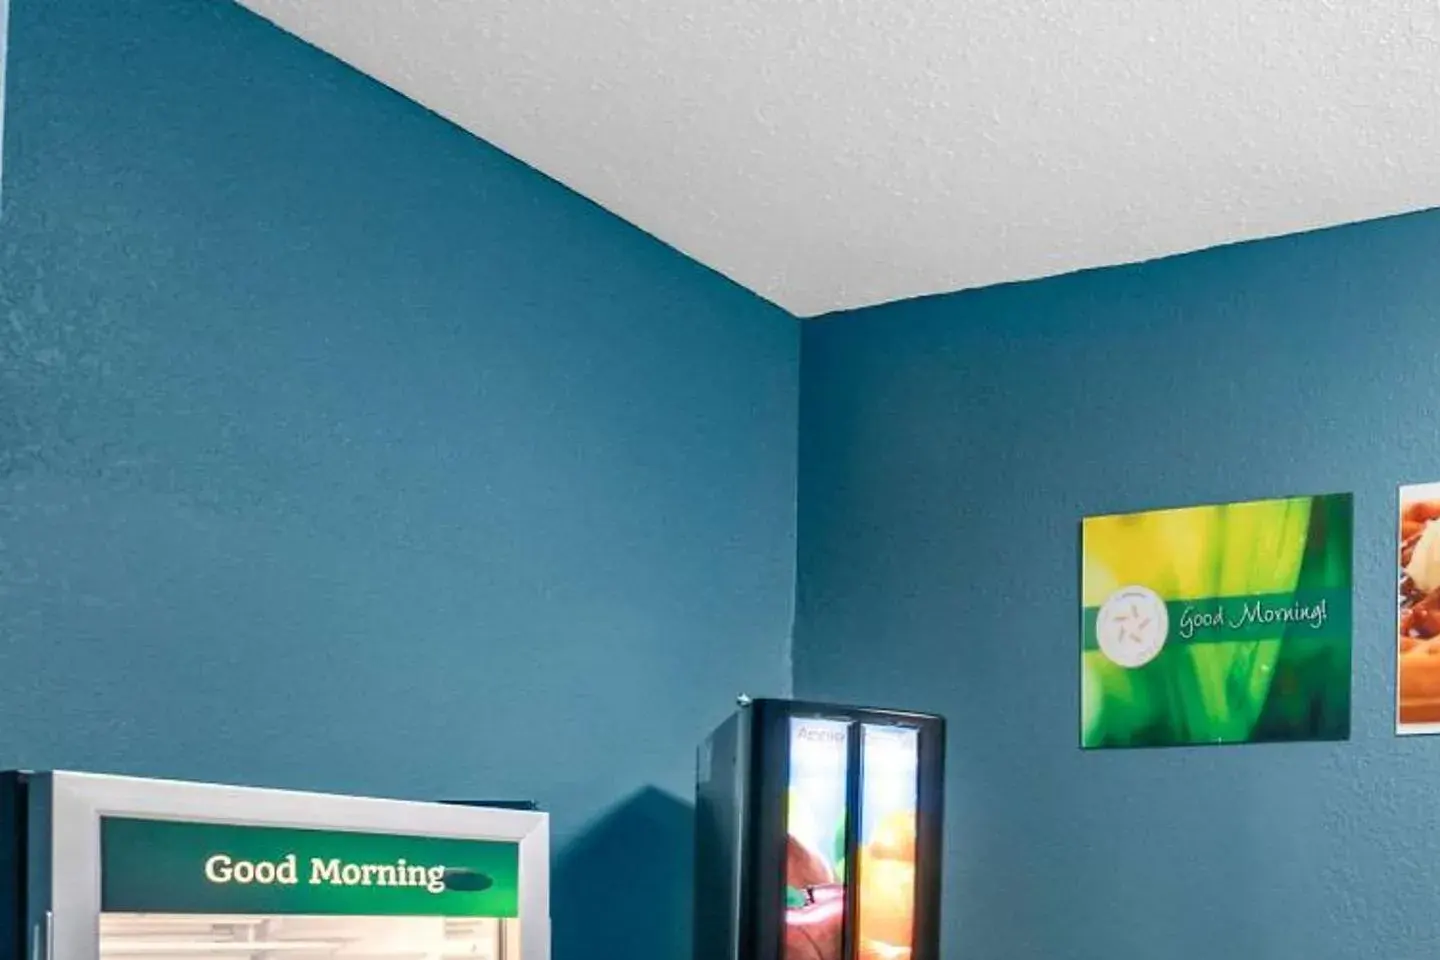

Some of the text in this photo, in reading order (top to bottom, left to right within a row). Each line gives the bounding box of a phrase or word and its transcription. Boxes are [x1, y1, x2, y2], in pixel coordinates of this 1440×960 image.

[1179, 599, 1328, 639] Good Morning!
[205, 853, 447, 893] Good Morning
